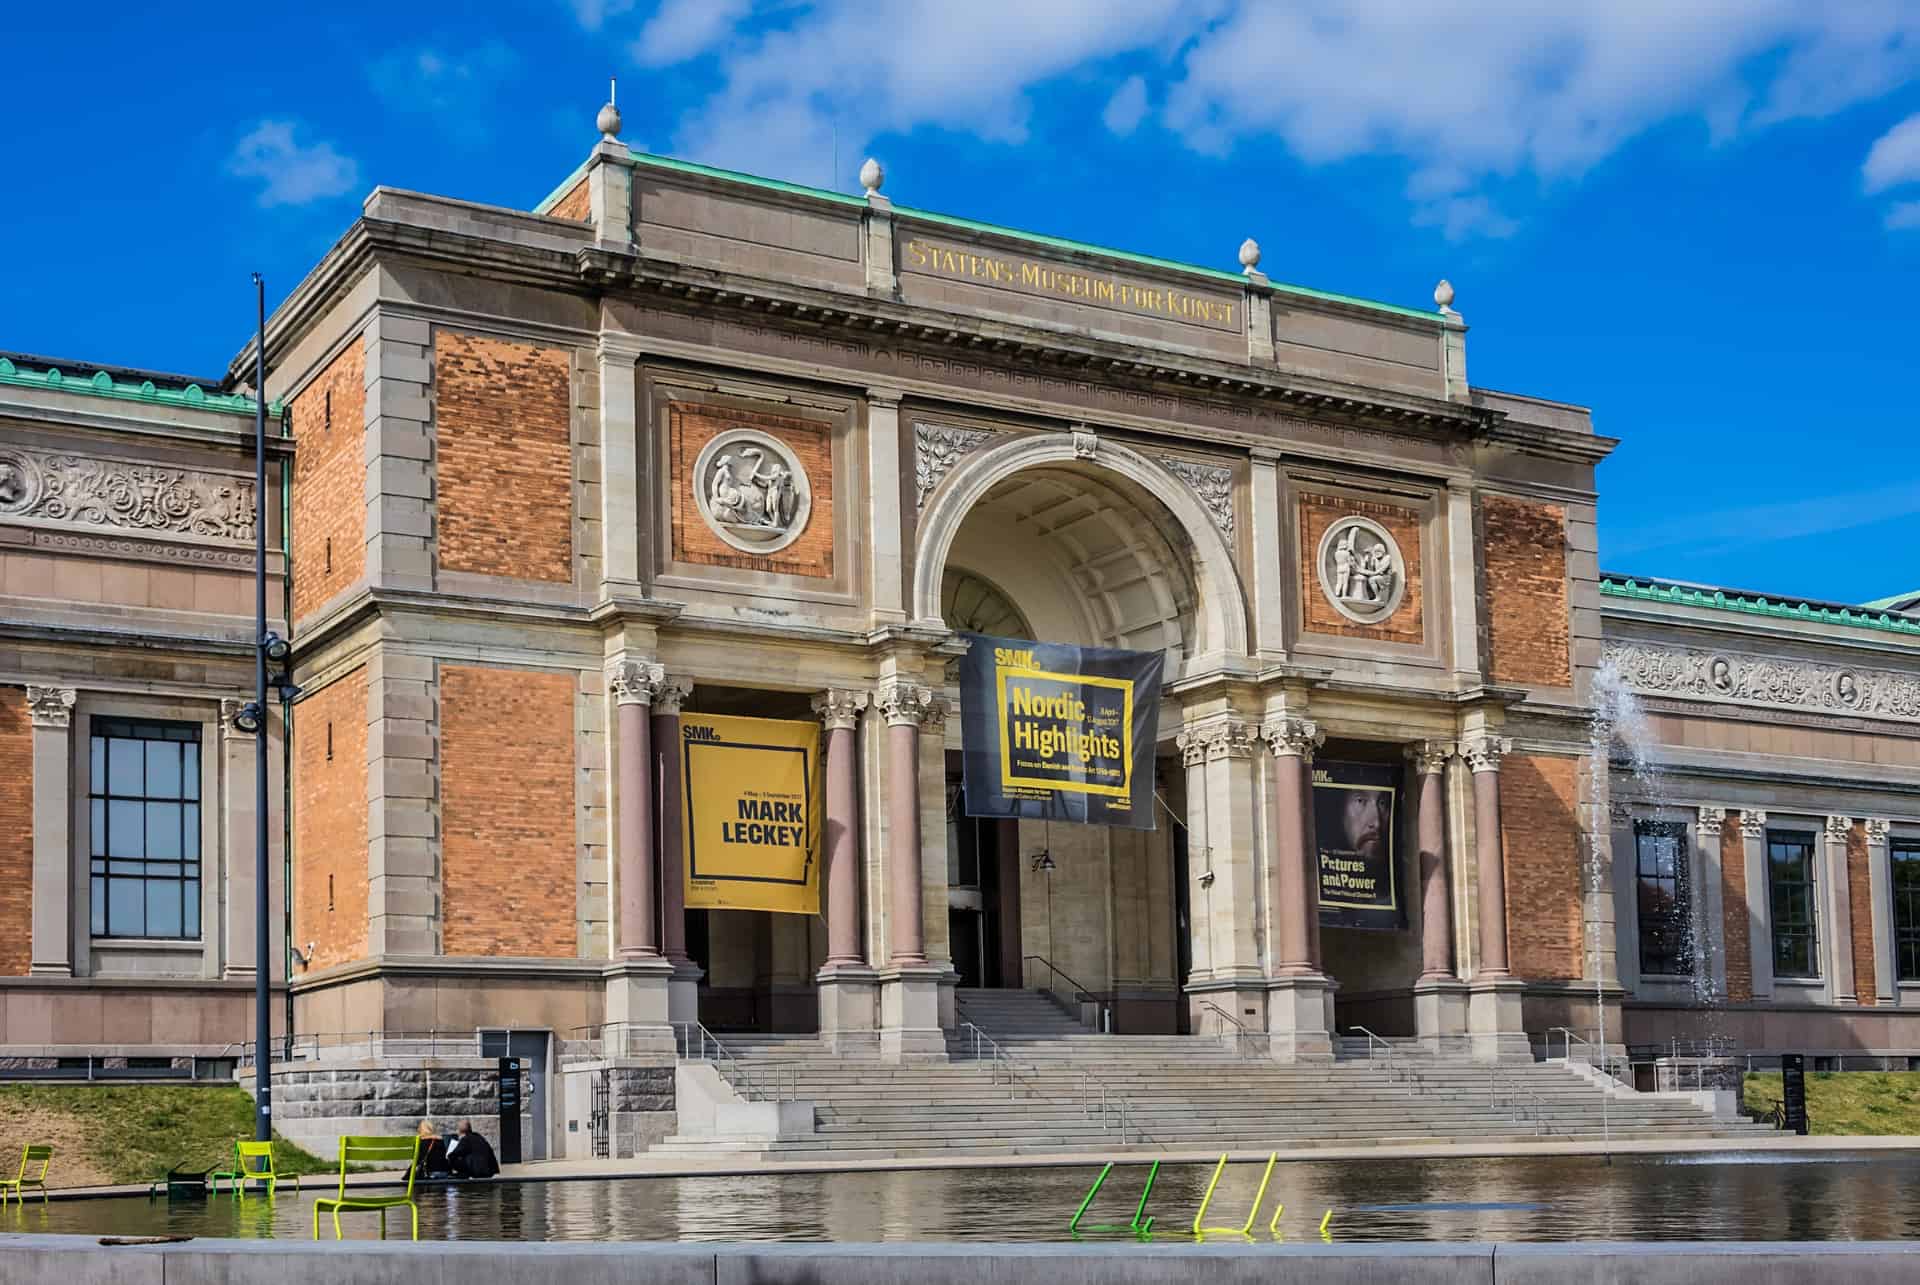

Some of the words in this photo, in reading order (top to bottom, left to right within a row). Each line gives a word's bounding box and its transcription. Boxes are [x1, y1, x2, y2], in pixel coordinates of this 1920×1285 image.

[908, 239, 1013, 282] STATENS
[1022, 262, 1115, 302] MUSEUM
[1167, 288, 1233, 324] KUNST
[1013, 688, 1086, 722] Nordic
[1014, 721, 1121, 762] Highlights
[1311, 770, 1328, 782] MK
[738, 800, 803, 823] MARK
[722, 822, 803, 847] LECKEY
[1321, 854, 1365, 872] Pctures
[1341, 873, 1376, 889] Power
